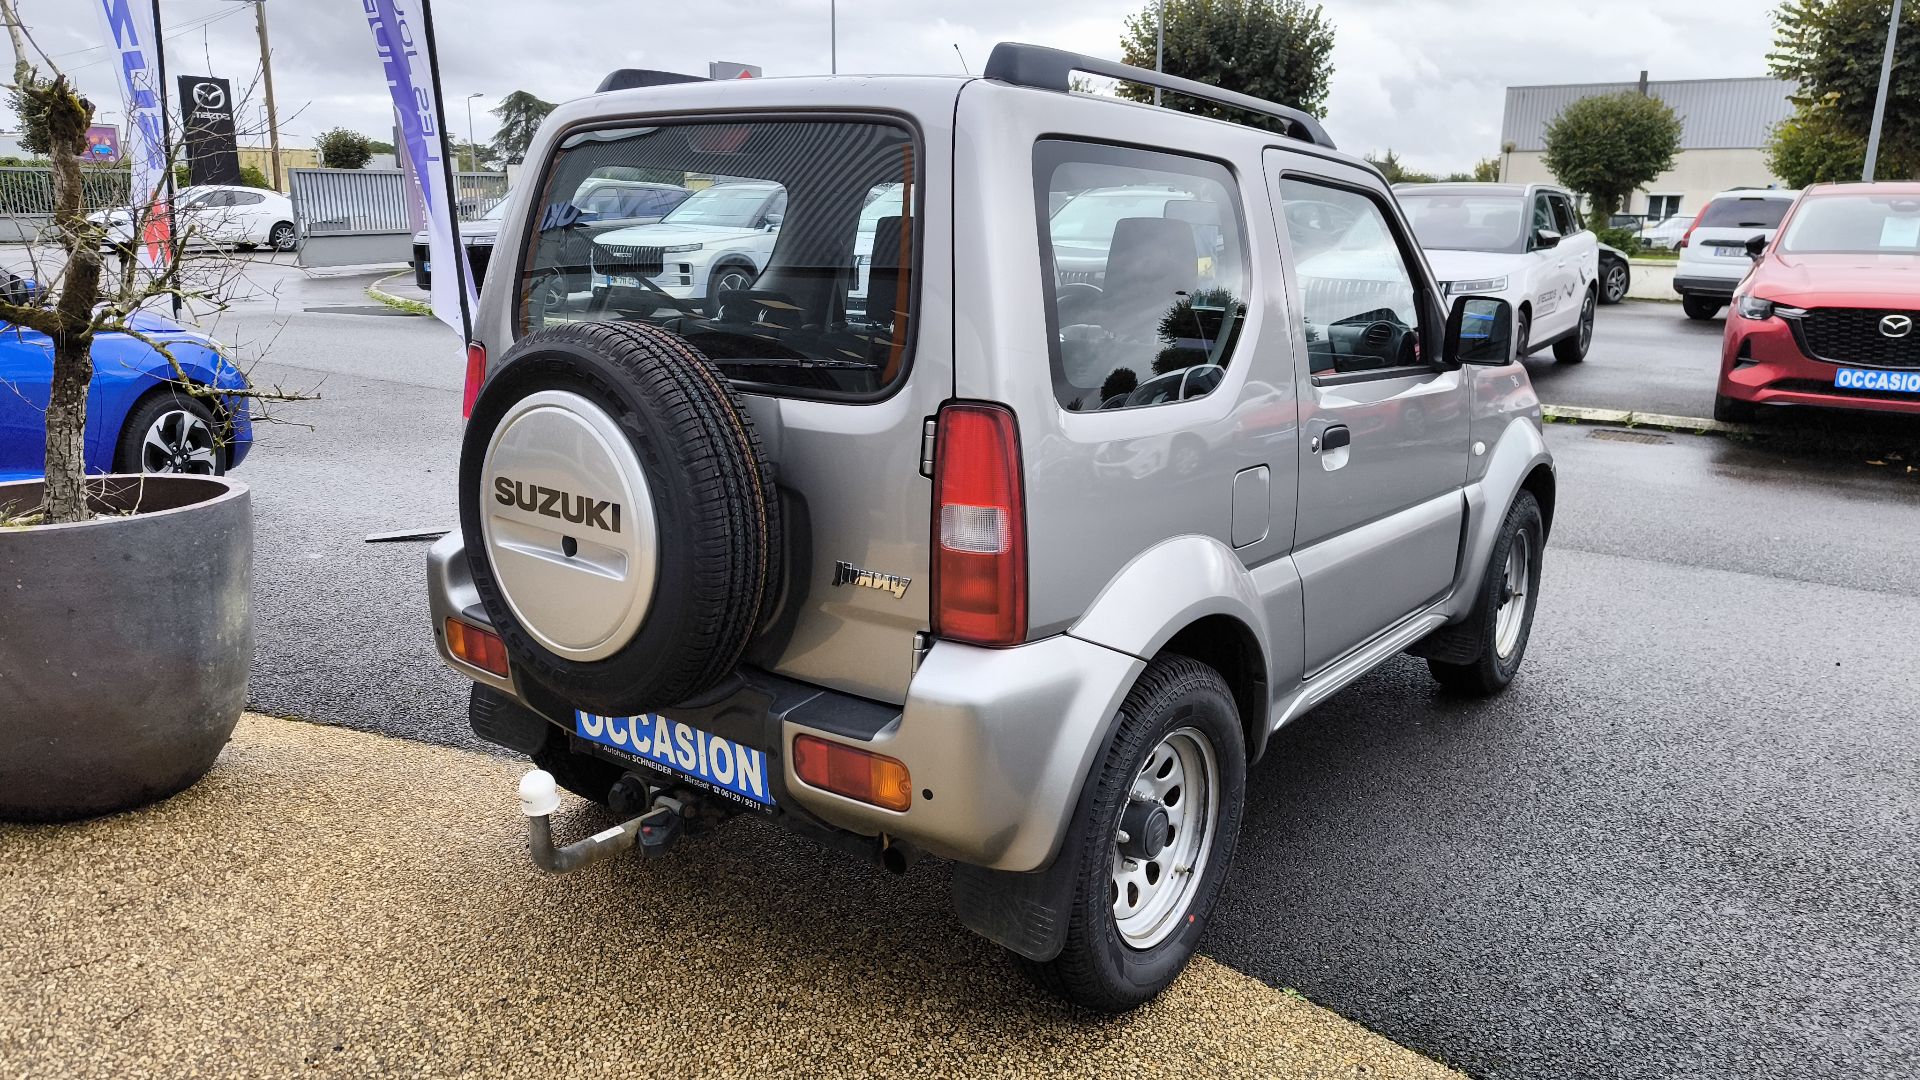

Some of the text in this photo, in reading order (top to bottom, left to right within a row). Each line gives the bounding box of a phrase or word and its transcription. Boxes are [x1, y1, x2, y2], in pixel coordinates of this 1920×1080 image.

[1838, 370, 1920, 391] OCCASIO
[494, 476, 621, 533] SUZUKI
[603, 744, 631, 761] Autohaus
[631, 754, 672, 776] SCHNEIDER
